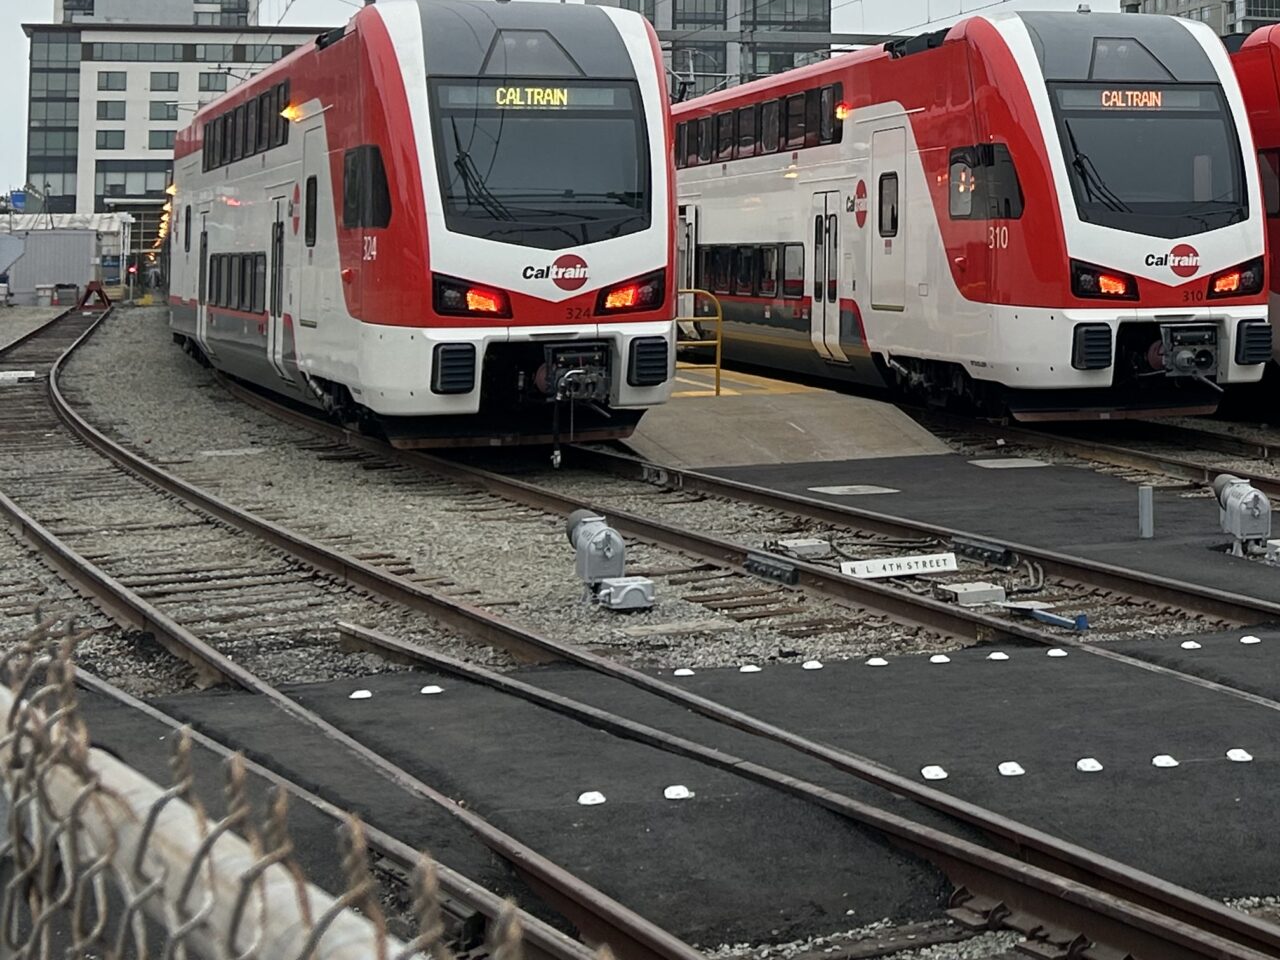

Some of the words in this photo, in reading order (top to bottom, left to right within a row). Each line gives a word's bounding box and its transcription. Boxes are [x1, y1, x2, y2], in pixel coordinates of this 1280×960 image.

[496, 87, 568, 106] CALTRAIN
[1102, 90, 1162, 107] CALTRAIN
[988, 226, 1009, 249] 310
[363, 235, 377, 261] 324
[1144, 253, 1202, 267] Caltrain
[522, 264, 590, 280] Caltrain
[1183, 290, 1204, 302] 310
[566, 307, 592, 320] 324
[882, 562, 903, 572] 4TH
[906, 558, 948, 570] STREET
